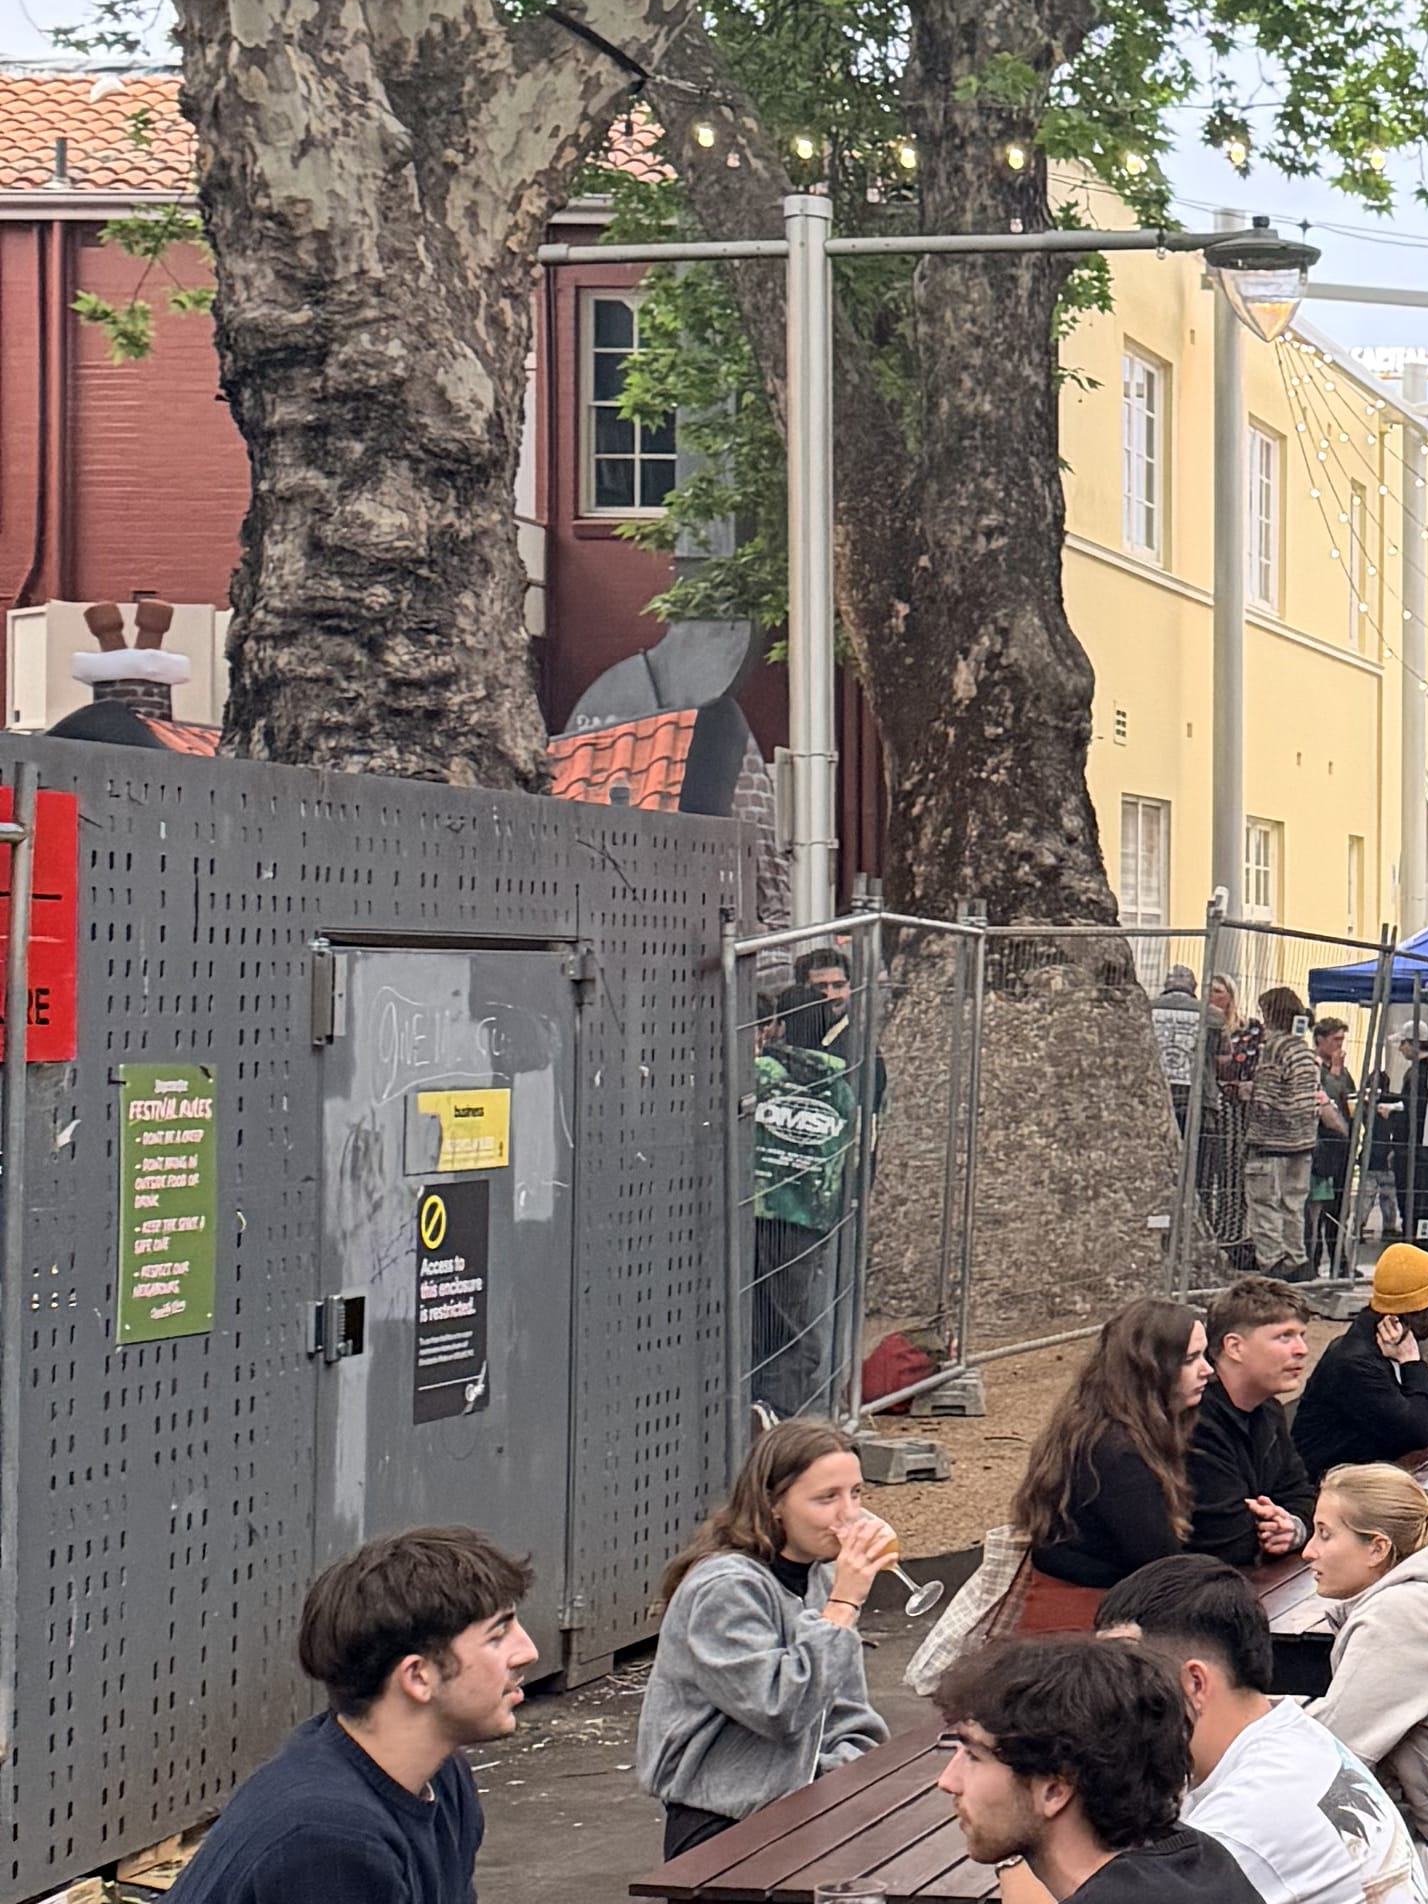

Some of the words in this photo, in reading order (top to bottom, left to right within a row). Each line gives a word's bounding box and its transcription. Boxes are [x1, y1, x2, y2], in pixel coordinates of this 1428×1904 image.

[129, 1097, 178, 1121] FESTIVAL
[420, 1257, 453, 1277] Access
[454, 1255, 466, 1273] to
[420, 1279, 438, 1300] this
[439, 1276, 483, 1297] enclosure
[420, 1304, 429, 1324] is
[429, 1296, 477, 1322] restricted.
